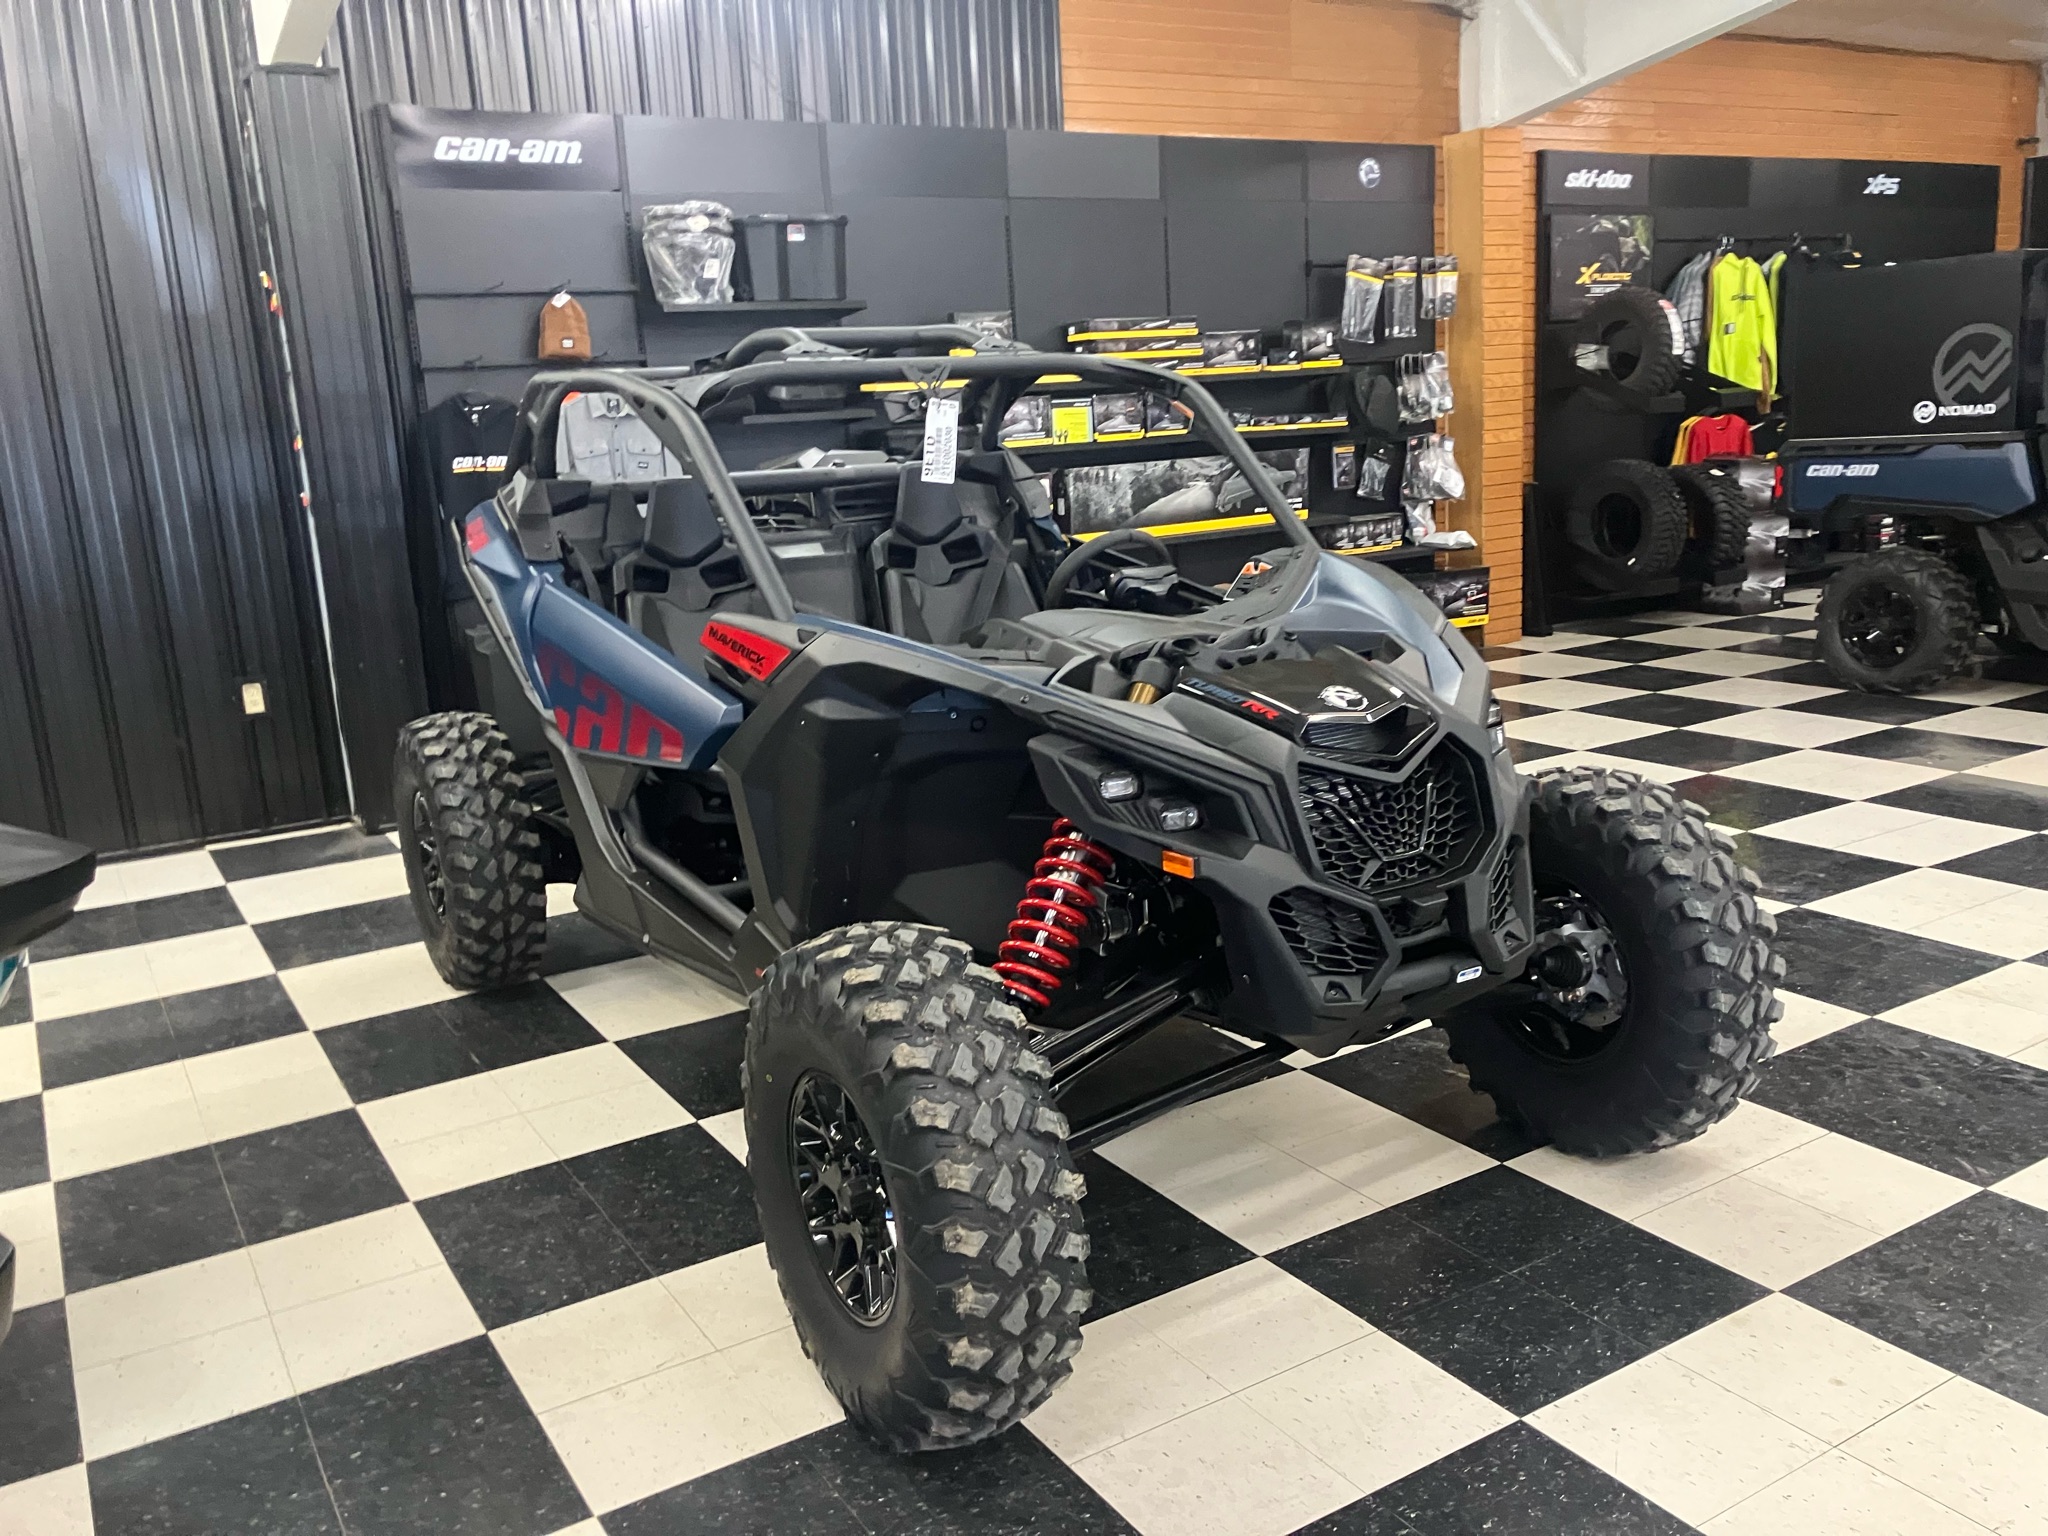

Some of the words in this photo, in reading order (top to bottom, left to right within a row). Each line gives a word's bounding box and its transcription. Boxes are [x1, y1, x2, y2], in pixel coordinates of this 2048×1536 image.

[433, 136, 583, 165] can-am
[1564, 168, 1634, 189] ski-doo
[1938, 403, 1997, 417] NOMAD
[1805, 463, 1880, 477] can-am
[1241, 699, 1281, 720] RR
